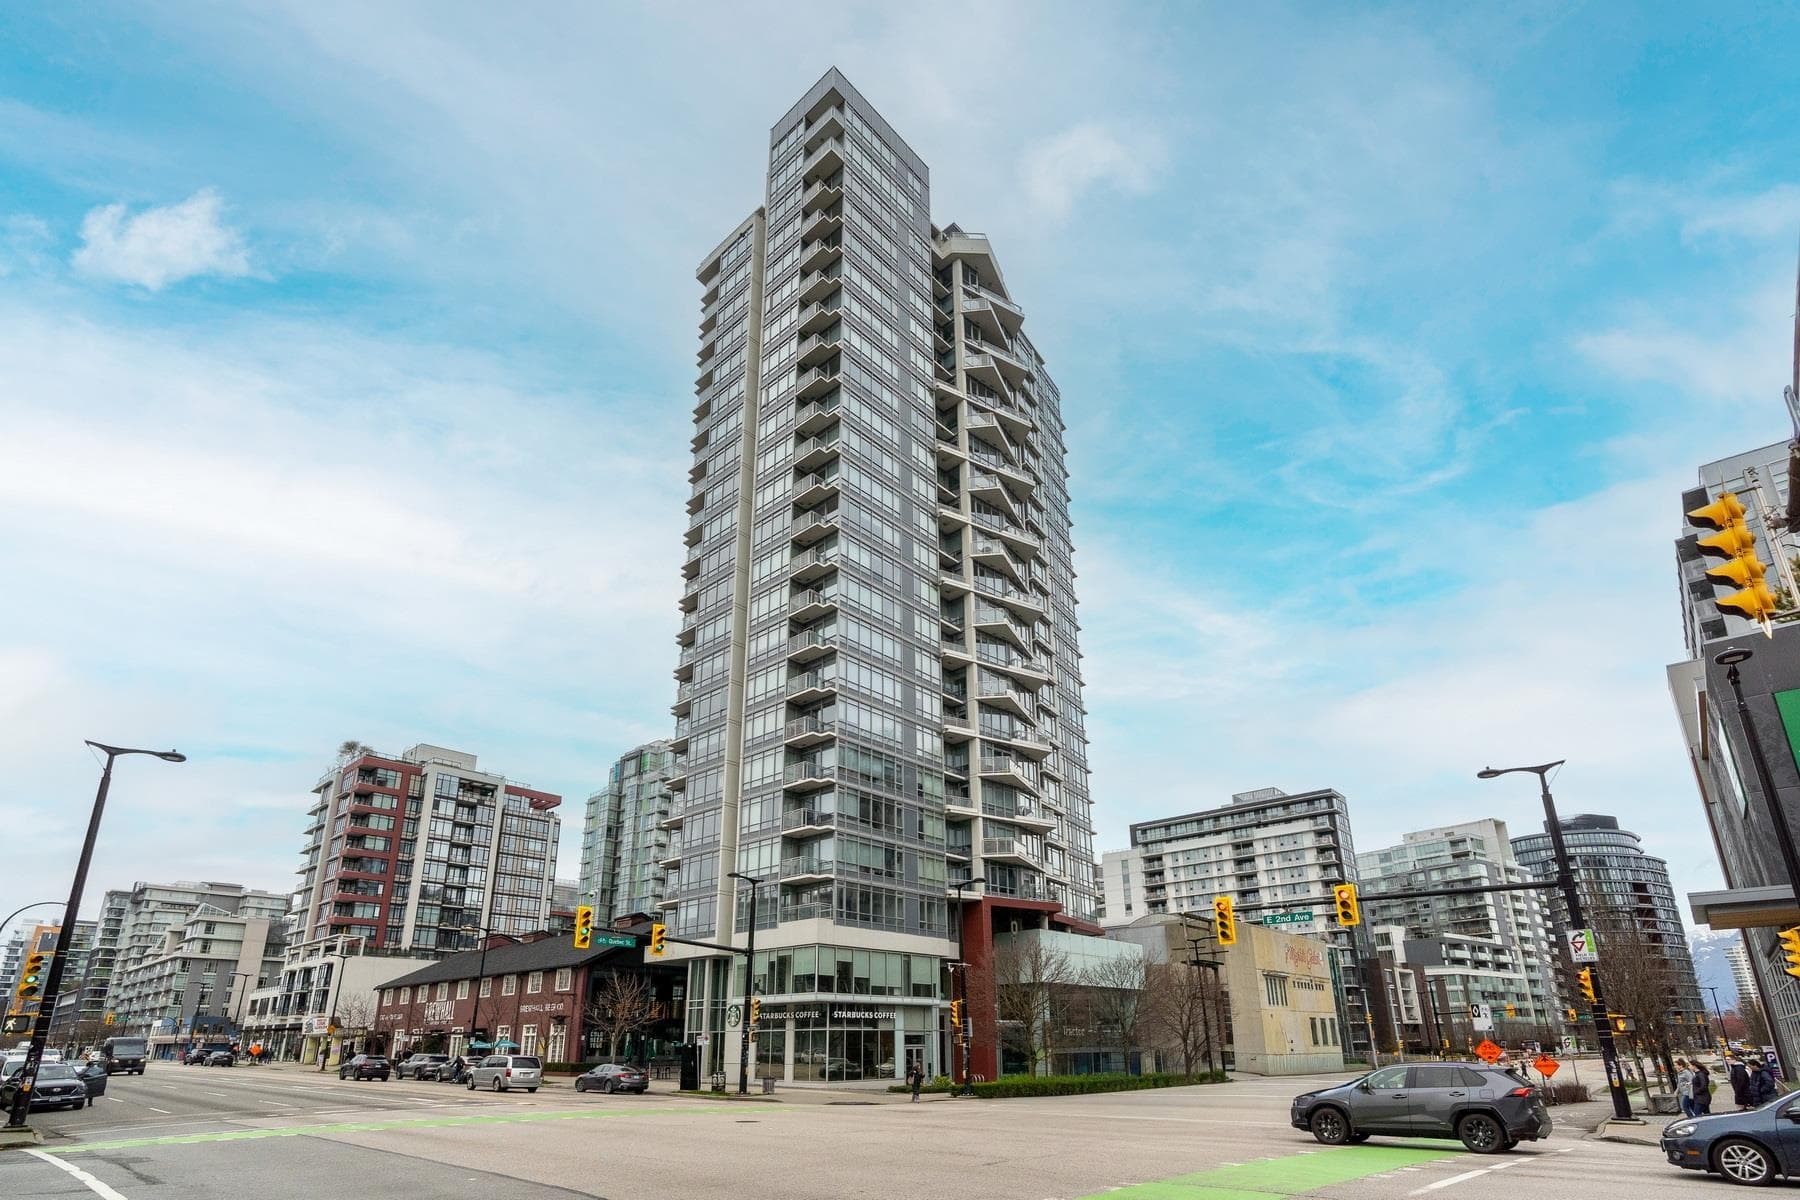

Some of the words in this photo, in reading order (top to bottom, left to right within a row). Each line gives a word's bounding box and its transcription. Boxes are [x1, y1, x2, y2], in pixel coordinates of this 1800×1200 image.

[1266, 916, 1273, 924] E
[1275, 914, 1291, 923] 2nd
[1294, 913, 1310, 921] Ave
[795, 1010, 819, 1019] COFFEE
[833, 1011, 873, 1019] STARBUCKS
[873, 1011, 896, 1019] COFFEE
[1766, 1053, 1776, 1063] P
